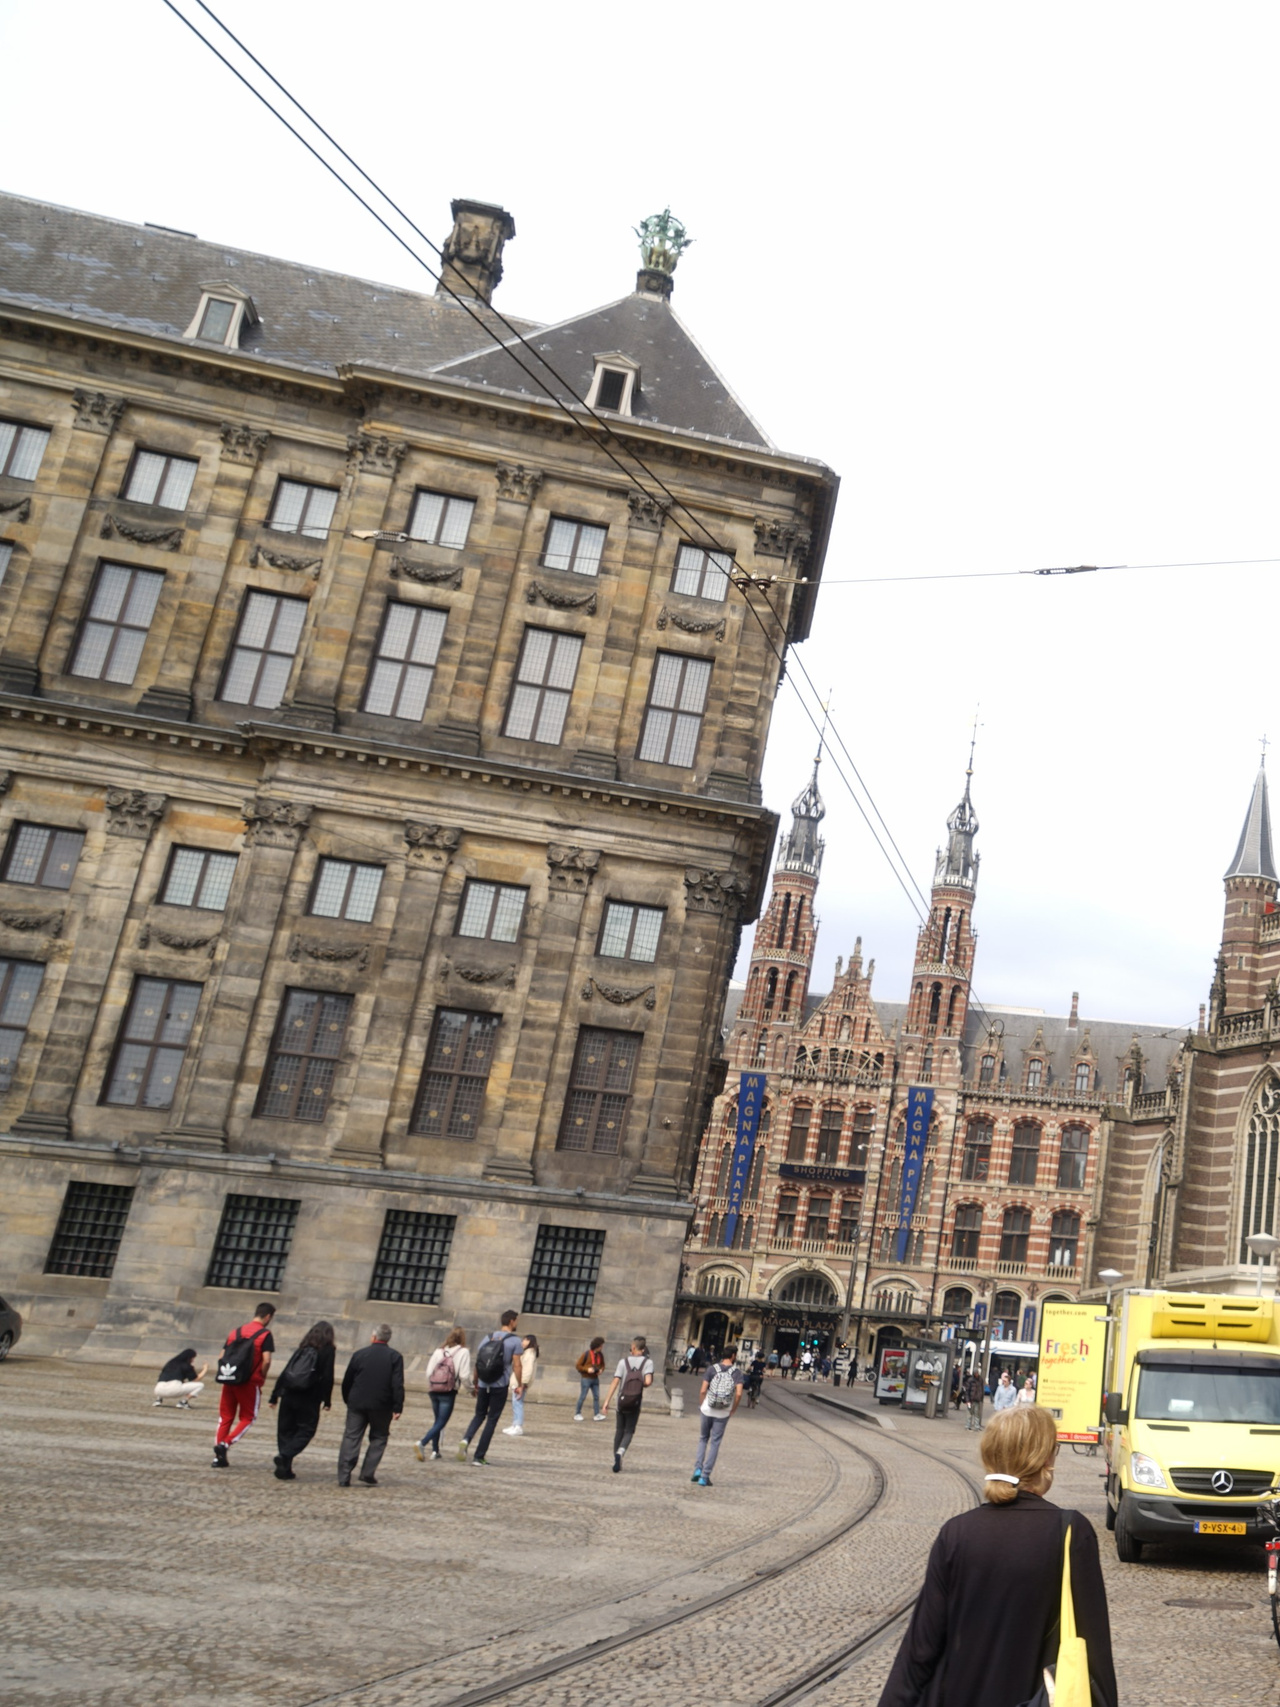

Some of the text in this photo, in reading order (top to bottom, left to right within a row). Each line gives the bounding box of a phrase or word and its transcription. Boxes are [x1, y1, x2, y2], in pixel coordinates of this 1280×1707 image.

[729, 1077, 758, 1215] MAGNA PLAZA
[901, 1091, 926, 1229] MAGNA PLAZA
[793, 1166, 850, 1178] SHOPPING
[762, 1317, 800, 1328] MAGNA
[803, 1320, 835, 1330] PLAZA
[1045, 1338, 1089, 1356] Fresh
[1041, 1353, 1077, 1369] together
